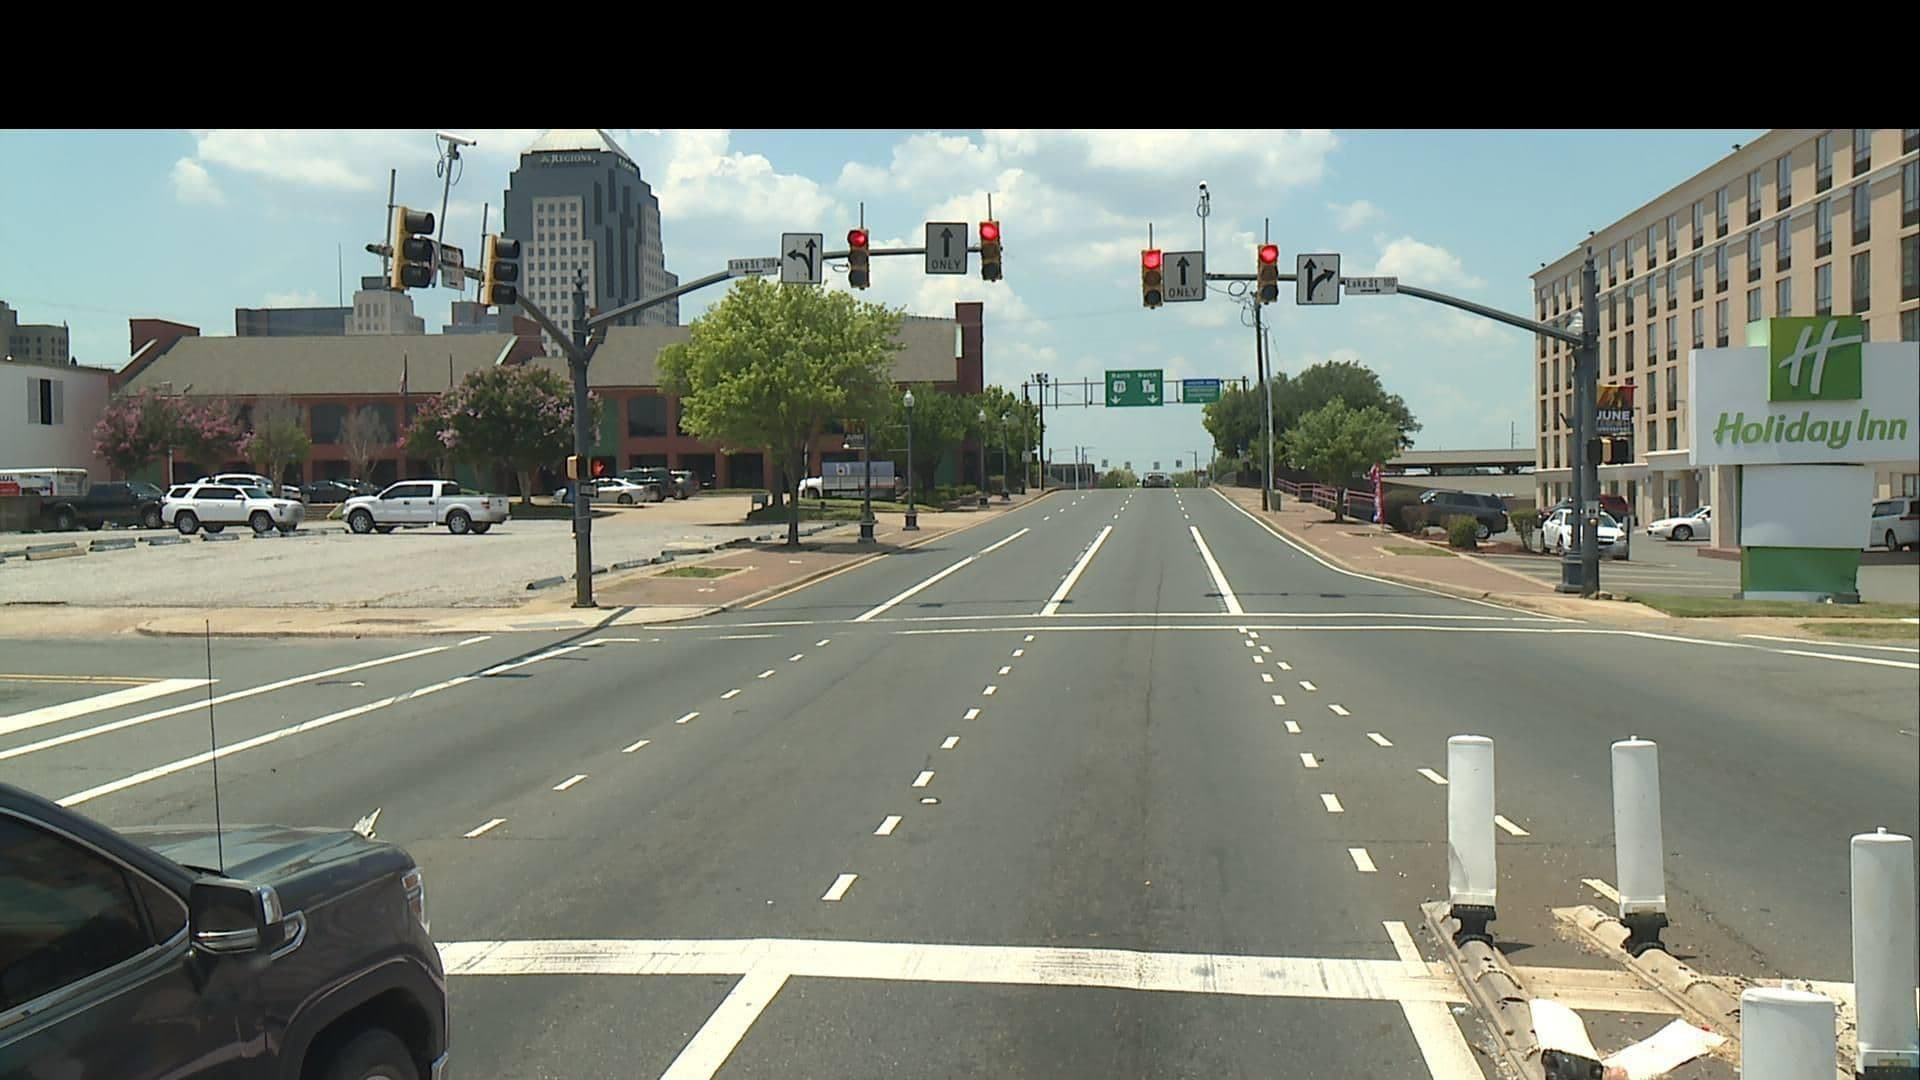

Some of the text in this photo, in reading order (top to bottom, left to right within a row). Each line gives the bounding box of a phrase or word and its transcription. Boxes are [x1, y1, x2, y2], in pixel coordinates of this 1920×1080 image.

[931, 259, 961, 270] ONLY
[1346, 279, 1367, 288] Lake
[1368, 278, 1378, 288] St
[1168, 287, 1199, 298] ONLY
[1596, 410, 1631, 421] JUNE
[1713, 408, 1908, 450] Holiday Inn
